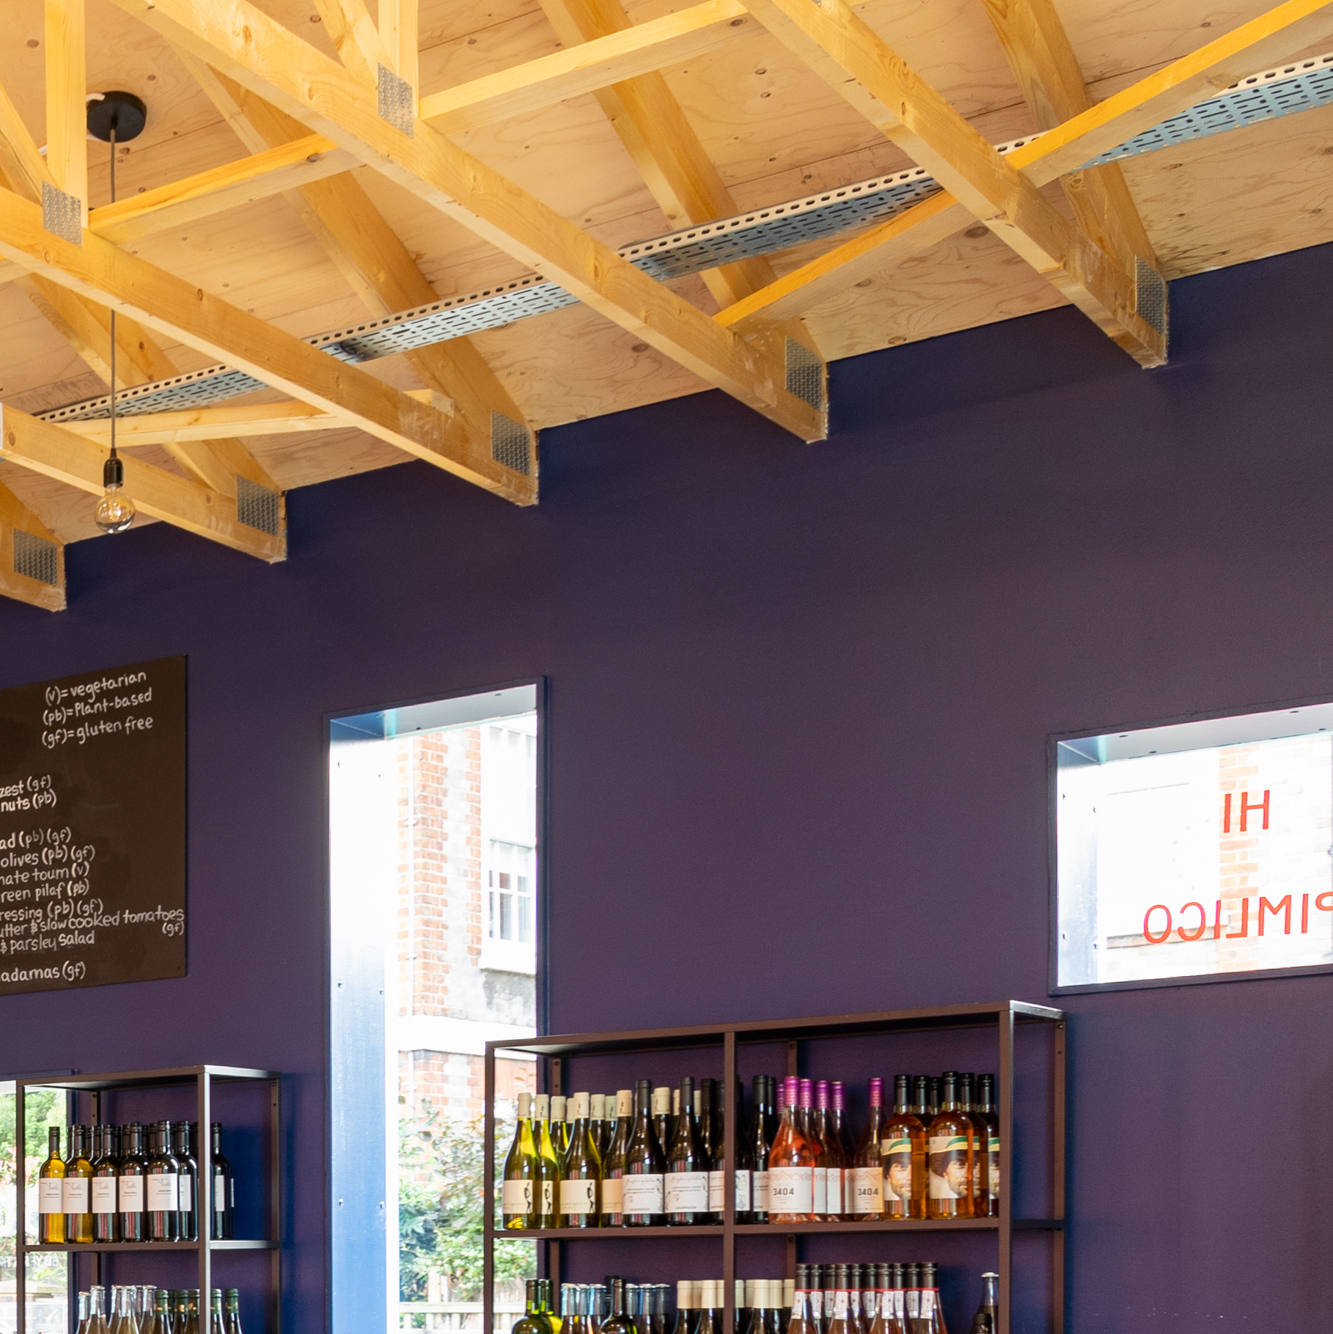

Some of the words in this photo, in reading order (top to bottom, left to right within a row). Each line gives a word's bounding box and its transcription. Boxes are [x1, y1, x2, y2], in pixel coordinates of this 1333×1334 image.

[124, 716, 154, 735] free
[0, 796, 31, 812] nuts
[122, 904, 185, 924] tomatoes
[58, 930, 95, 946] salad
[62, 960, 86, 981] (gf)
[773, 1187, 795, 1196] 3404
[857, 1187, 879, 1196] 3404
